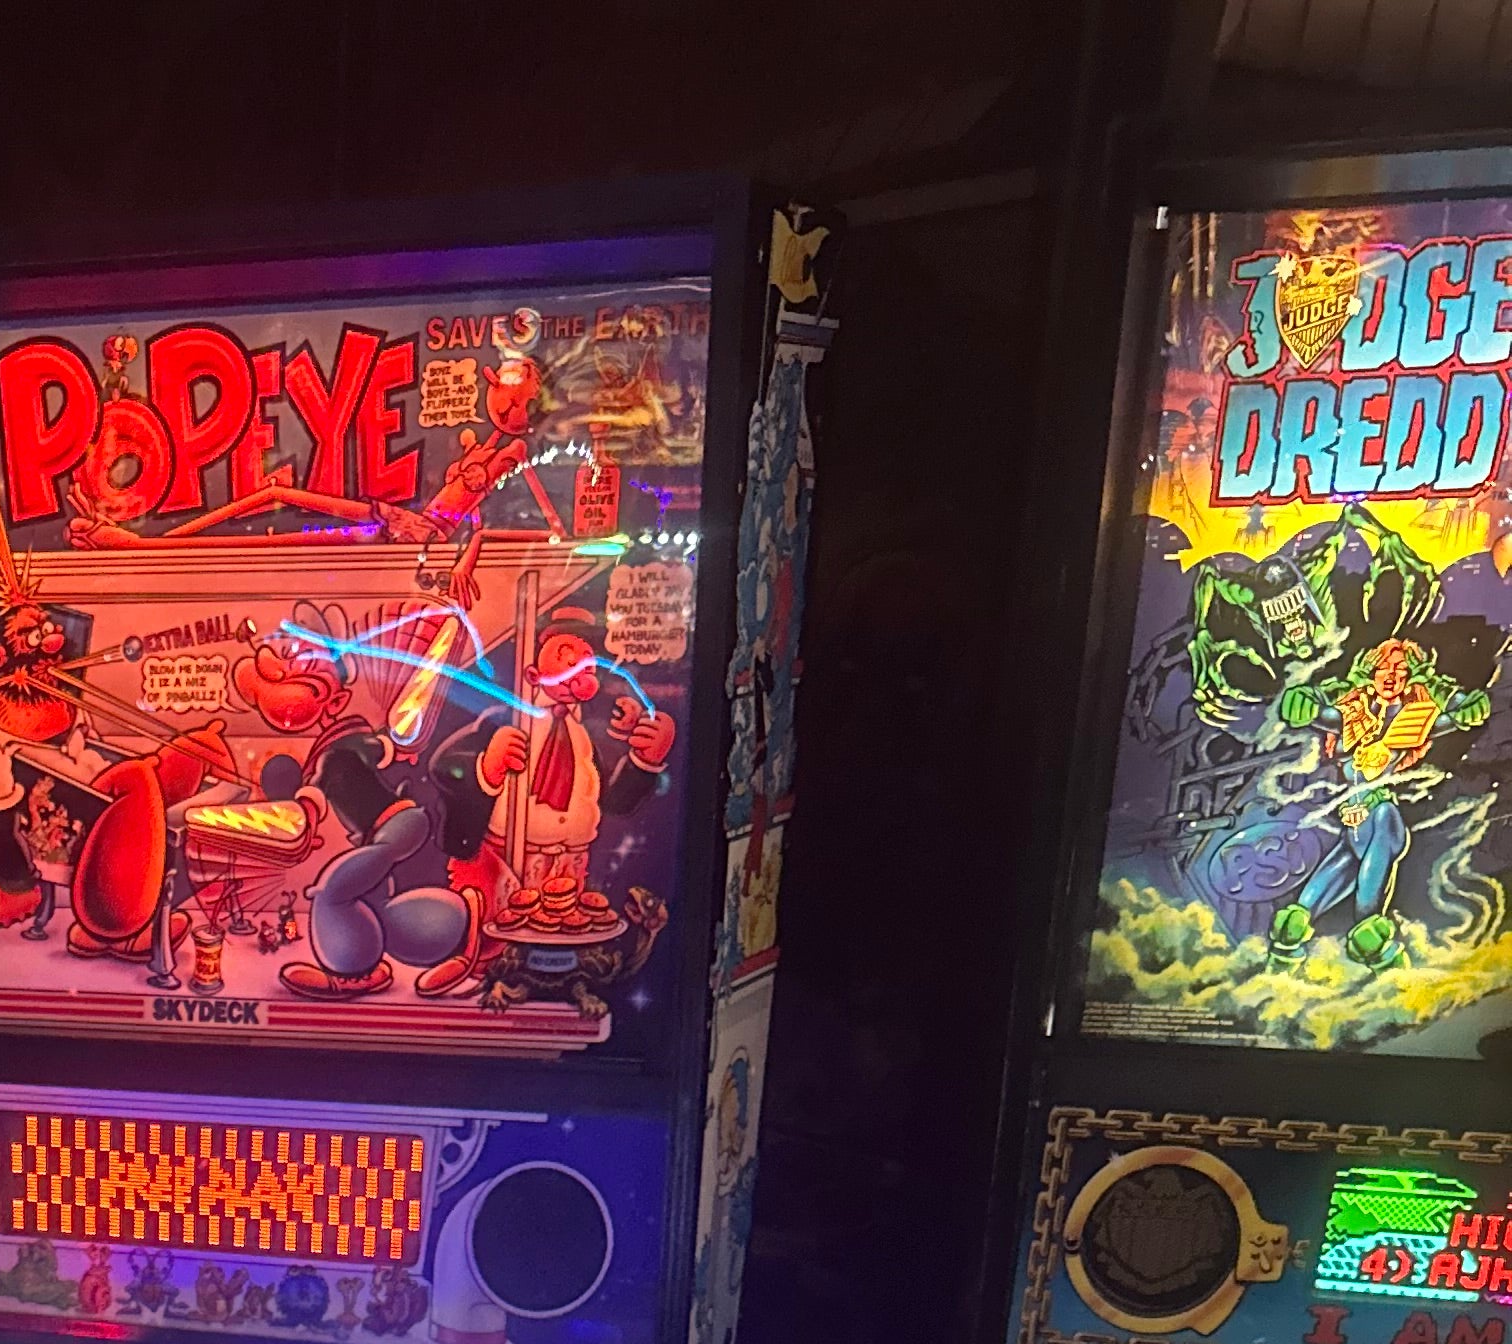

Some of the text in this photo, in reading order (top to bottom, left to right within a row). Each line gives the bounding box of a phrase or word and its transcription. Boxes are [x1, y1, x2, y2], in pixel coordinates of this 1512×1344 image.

[1221, 233, 1512, 378] JDGE
[539, 314, 587, 340] THE
[1209, 371, 1509, 507] DREDD
[144, 614, 233, 654] EXTRA BALL
[152, 999, 260, 1026] SKYDECK
[1449, 1212, 1512, 1252] HI
[1360, 1247, 1412, 1284] 4)
